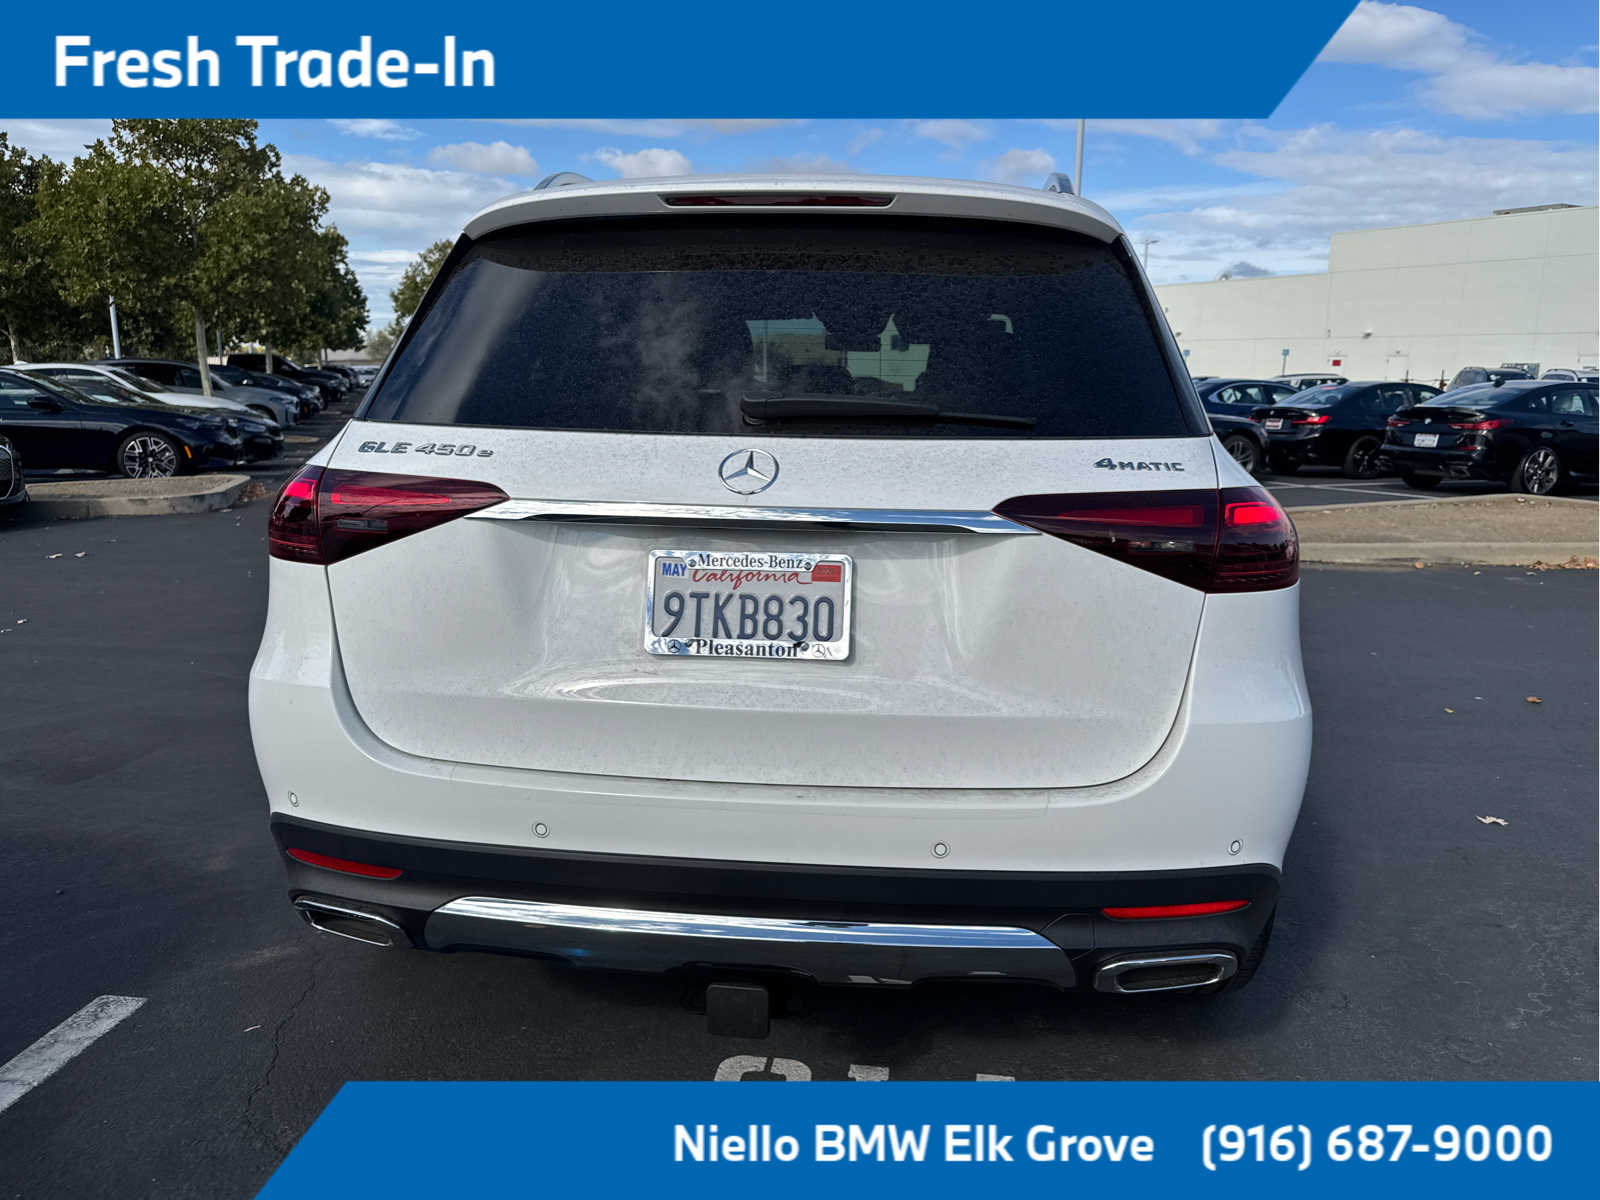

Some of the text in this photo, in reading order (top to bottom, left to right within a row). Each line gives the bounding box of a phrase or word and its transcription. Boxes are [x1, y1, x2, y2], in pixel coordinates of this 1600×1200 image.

[358, 441, 412, 454] GLE
[1093, 457, 1185, 472] 4MATIC
[662, 562, 687, 577] MAY
[698, 553, 804, 570] Mercedes-Benz
[691, 569, 813, 591] California
[661, 591, 835, 642] 9TKB830
[693, 638, 797, 658] Pleasanton
